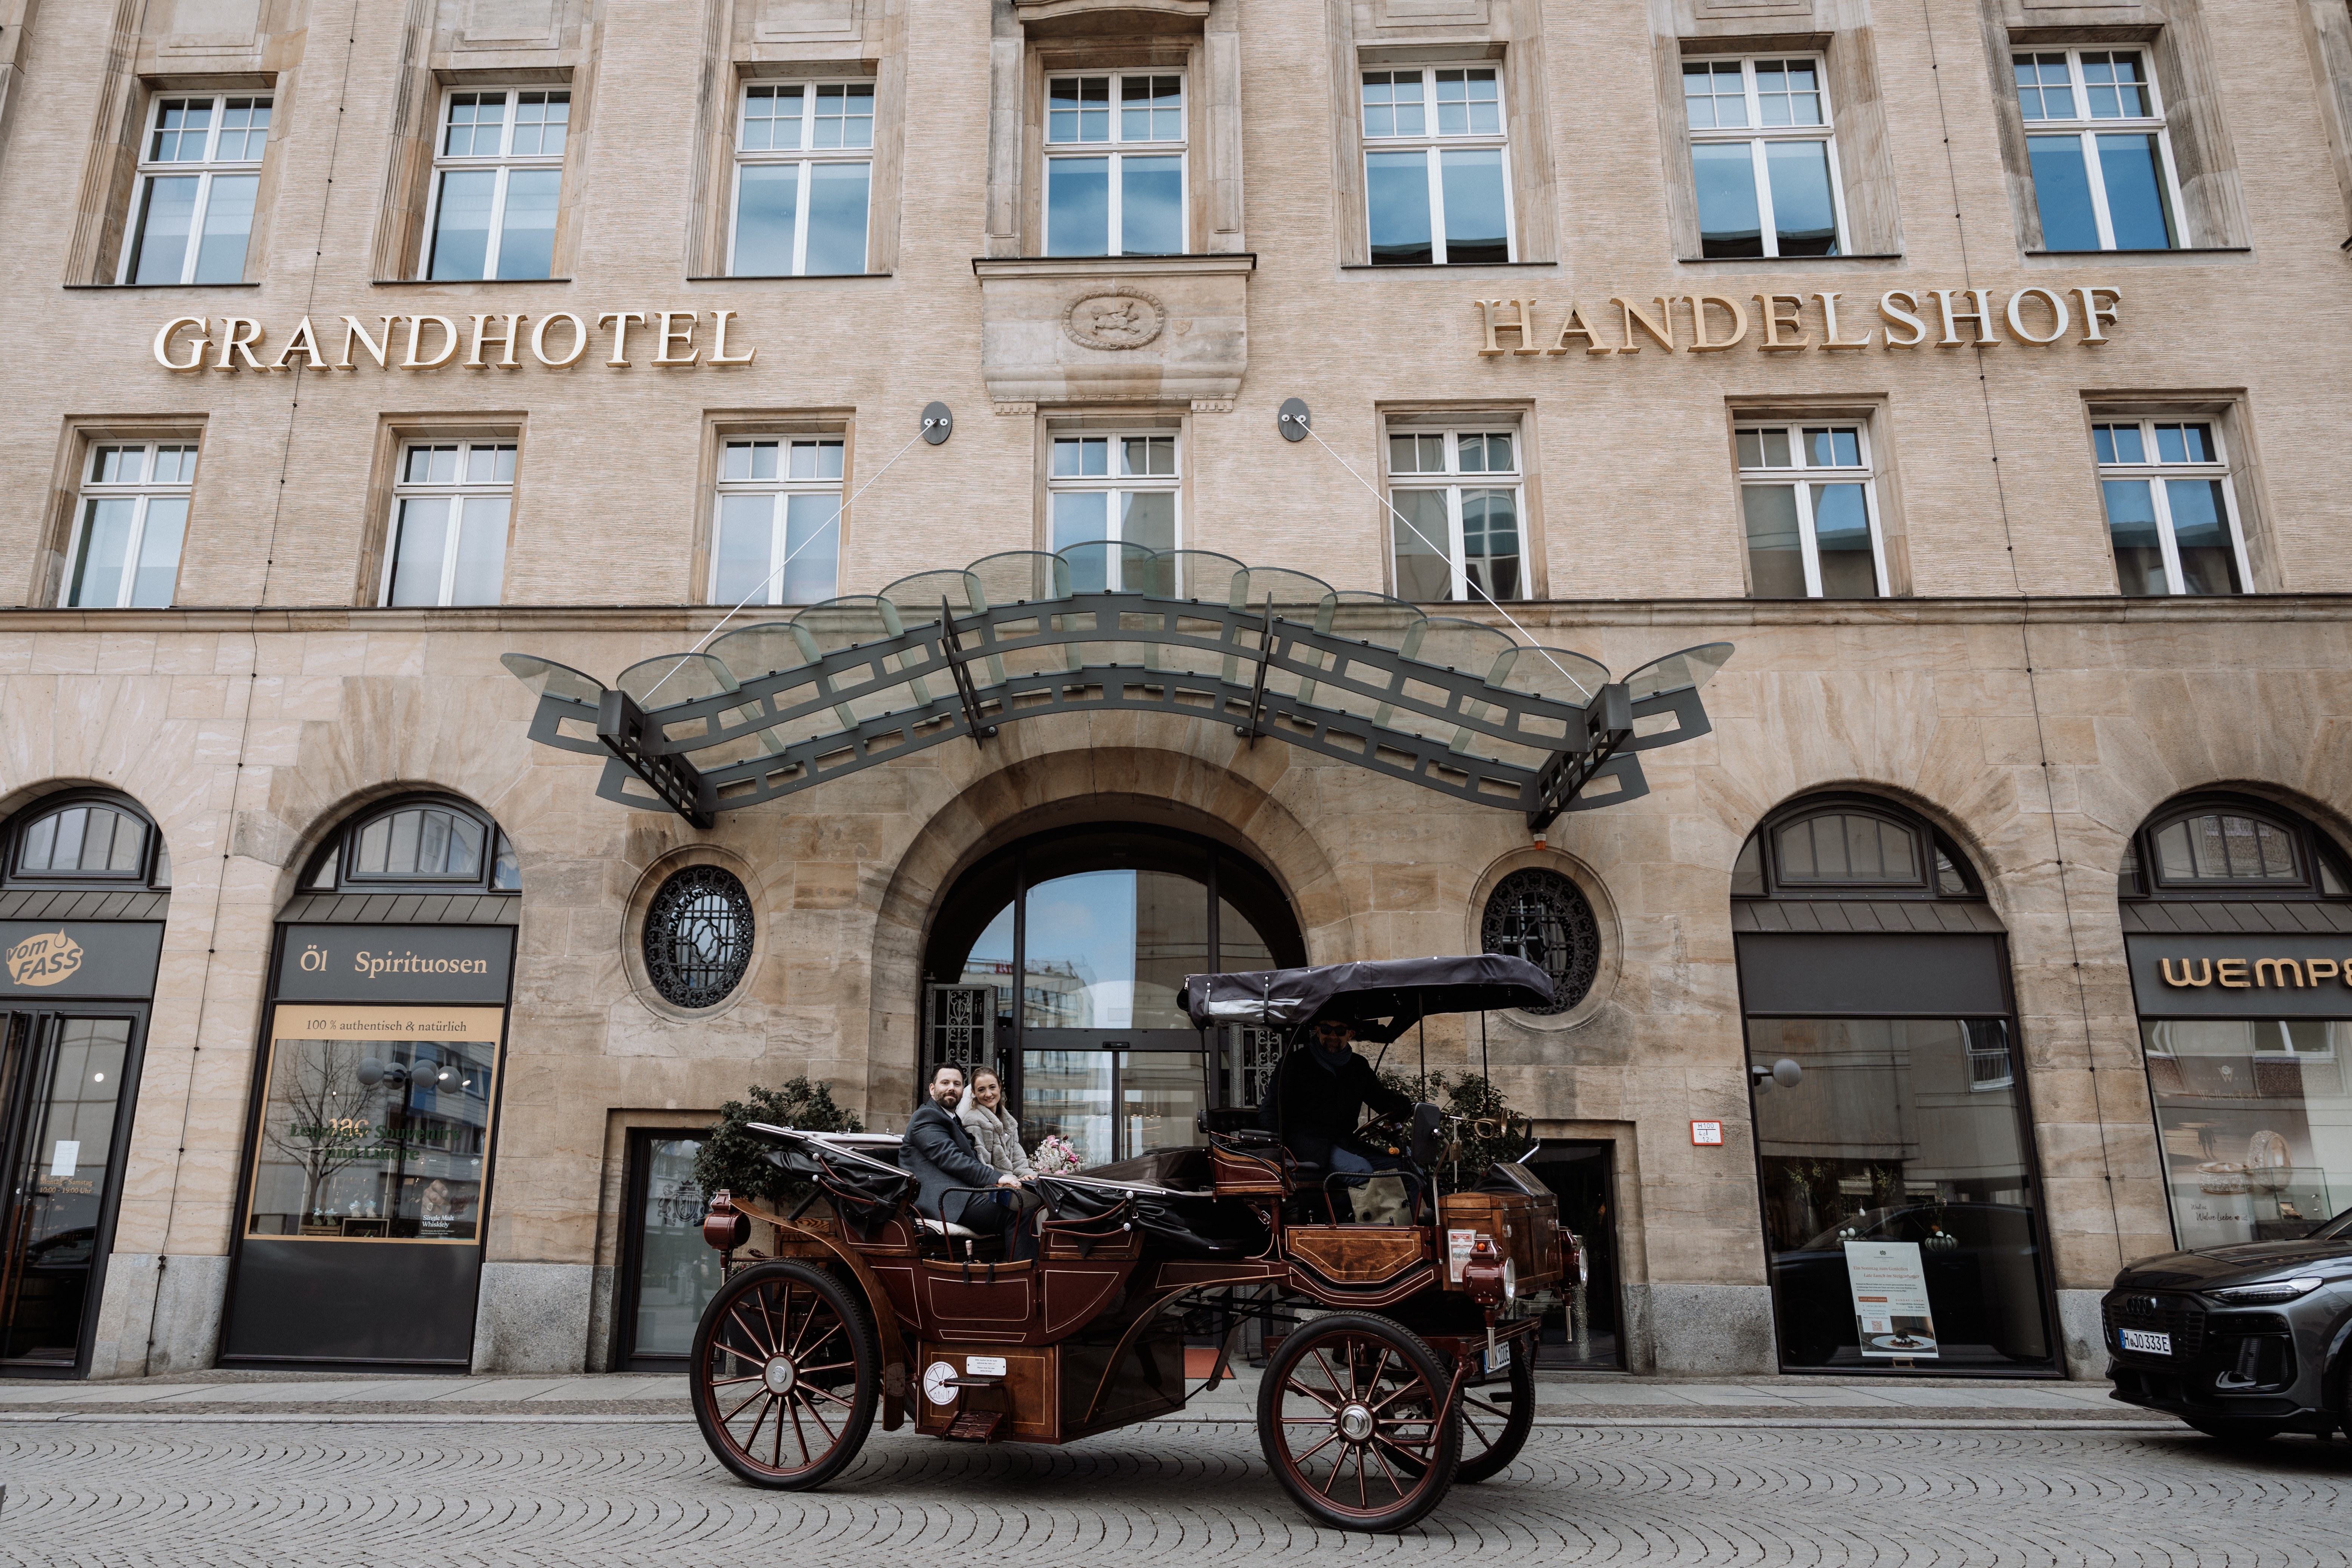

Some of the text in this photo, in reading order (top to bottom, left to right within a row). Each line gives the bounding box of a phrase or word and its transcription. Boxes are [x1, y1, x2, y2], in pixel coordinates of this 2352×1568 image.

[1474, 287, 2121, 356] HANDELSHOF
[153, 310, 756, 373] GRANDHOTEL
[8, 940, 48, 962] vom
[15, 948, 81, 982] FASS
[300, 945, 487, 978] Öl Spirituosen
[306, 1020, 467, 1032] 100 % authentisch & natürlich
[2197, 1089, 2263, 1101] Wellendorff
[290, 1123, 371, 1141] Leipziger
[374, 1125, 460, 1140] Souvenirs
[325, 1145, 419, 1160] und Liköre
[2196, 1212, 2216, 1221] Wahre
[2217, 1213, 2233, 1221] Liebe
[2123, 1332, 2130, 1346] H
[2134, 1333, 2144, 1348] JO
